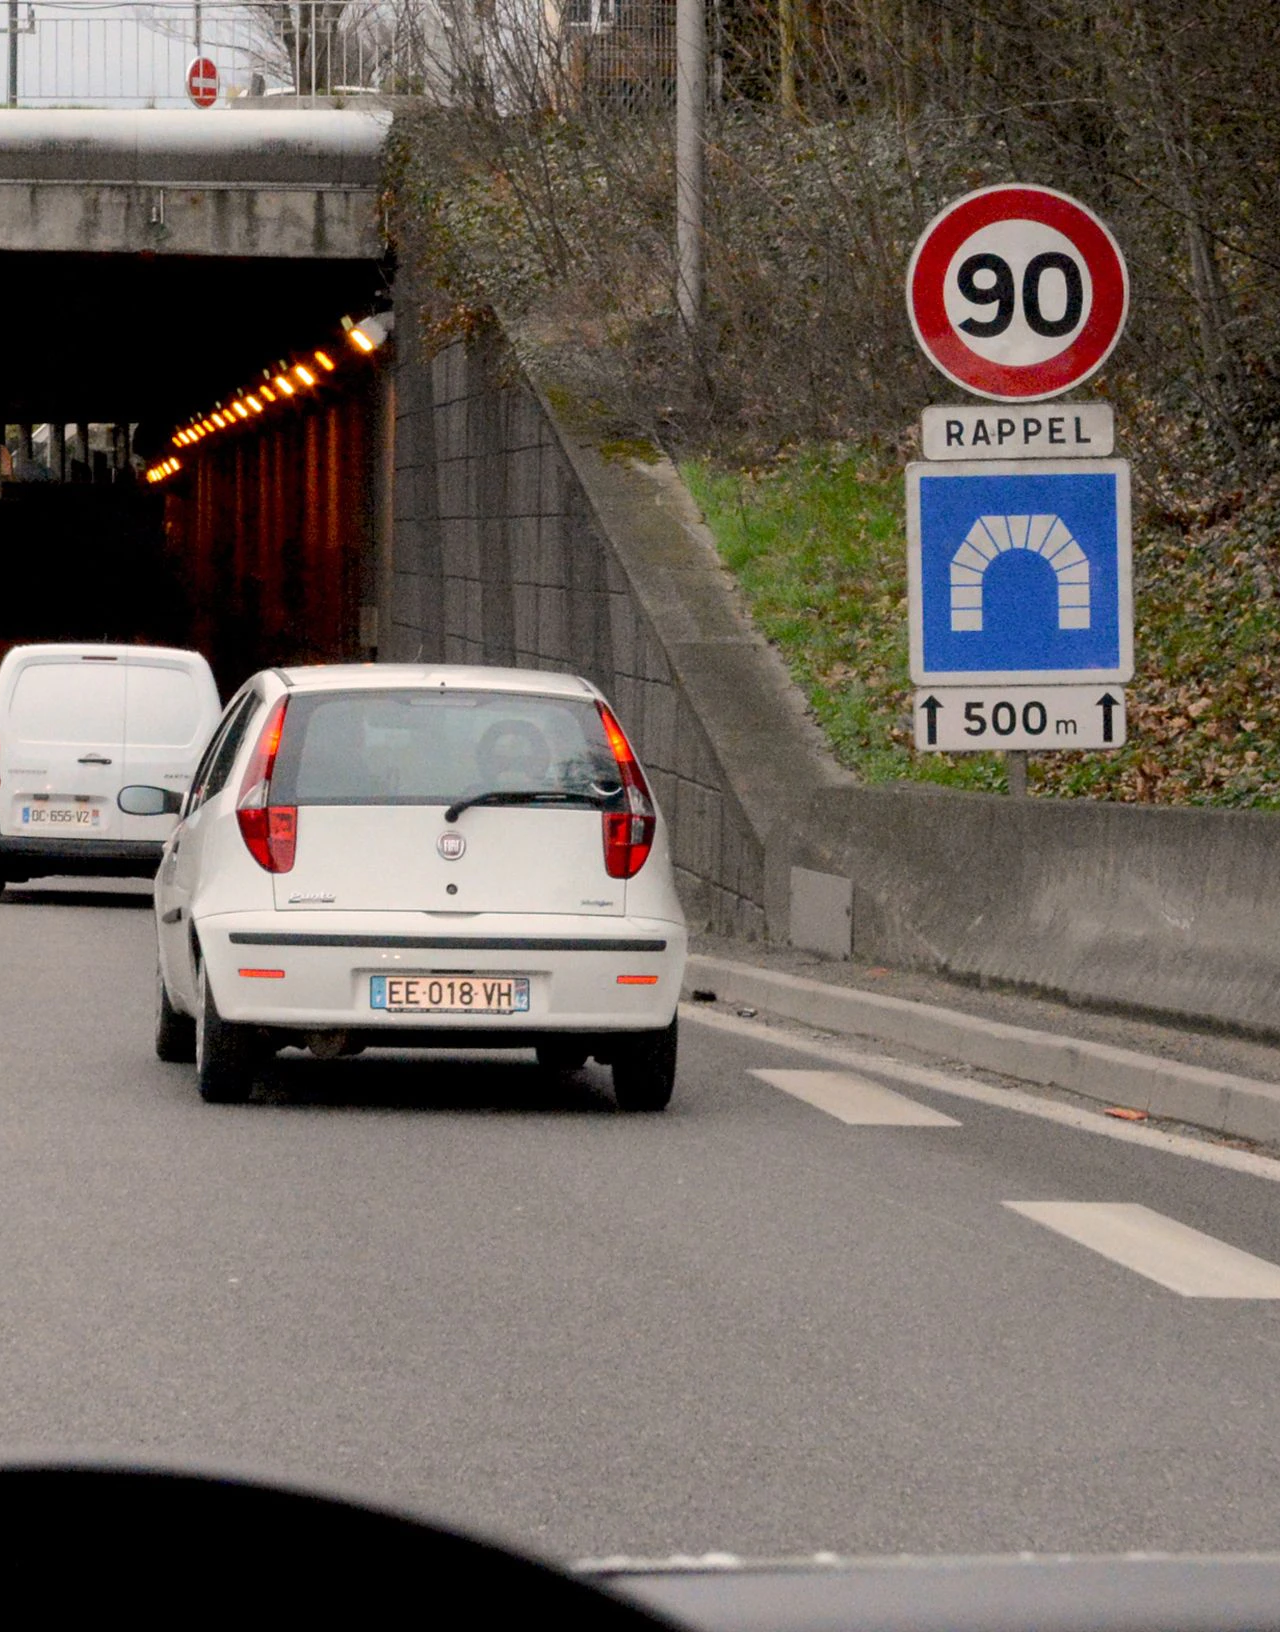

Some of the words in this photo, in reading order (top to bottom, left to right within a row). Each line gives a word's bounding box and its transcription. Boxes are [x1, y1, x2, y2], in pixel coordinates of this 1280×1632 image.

[957, 252, 1083, 338] 90
[945, 417, 1091, 446] RAPPEL
[964, 701, 1047, 736] 500
[1056, 718, 1078, 735] m
